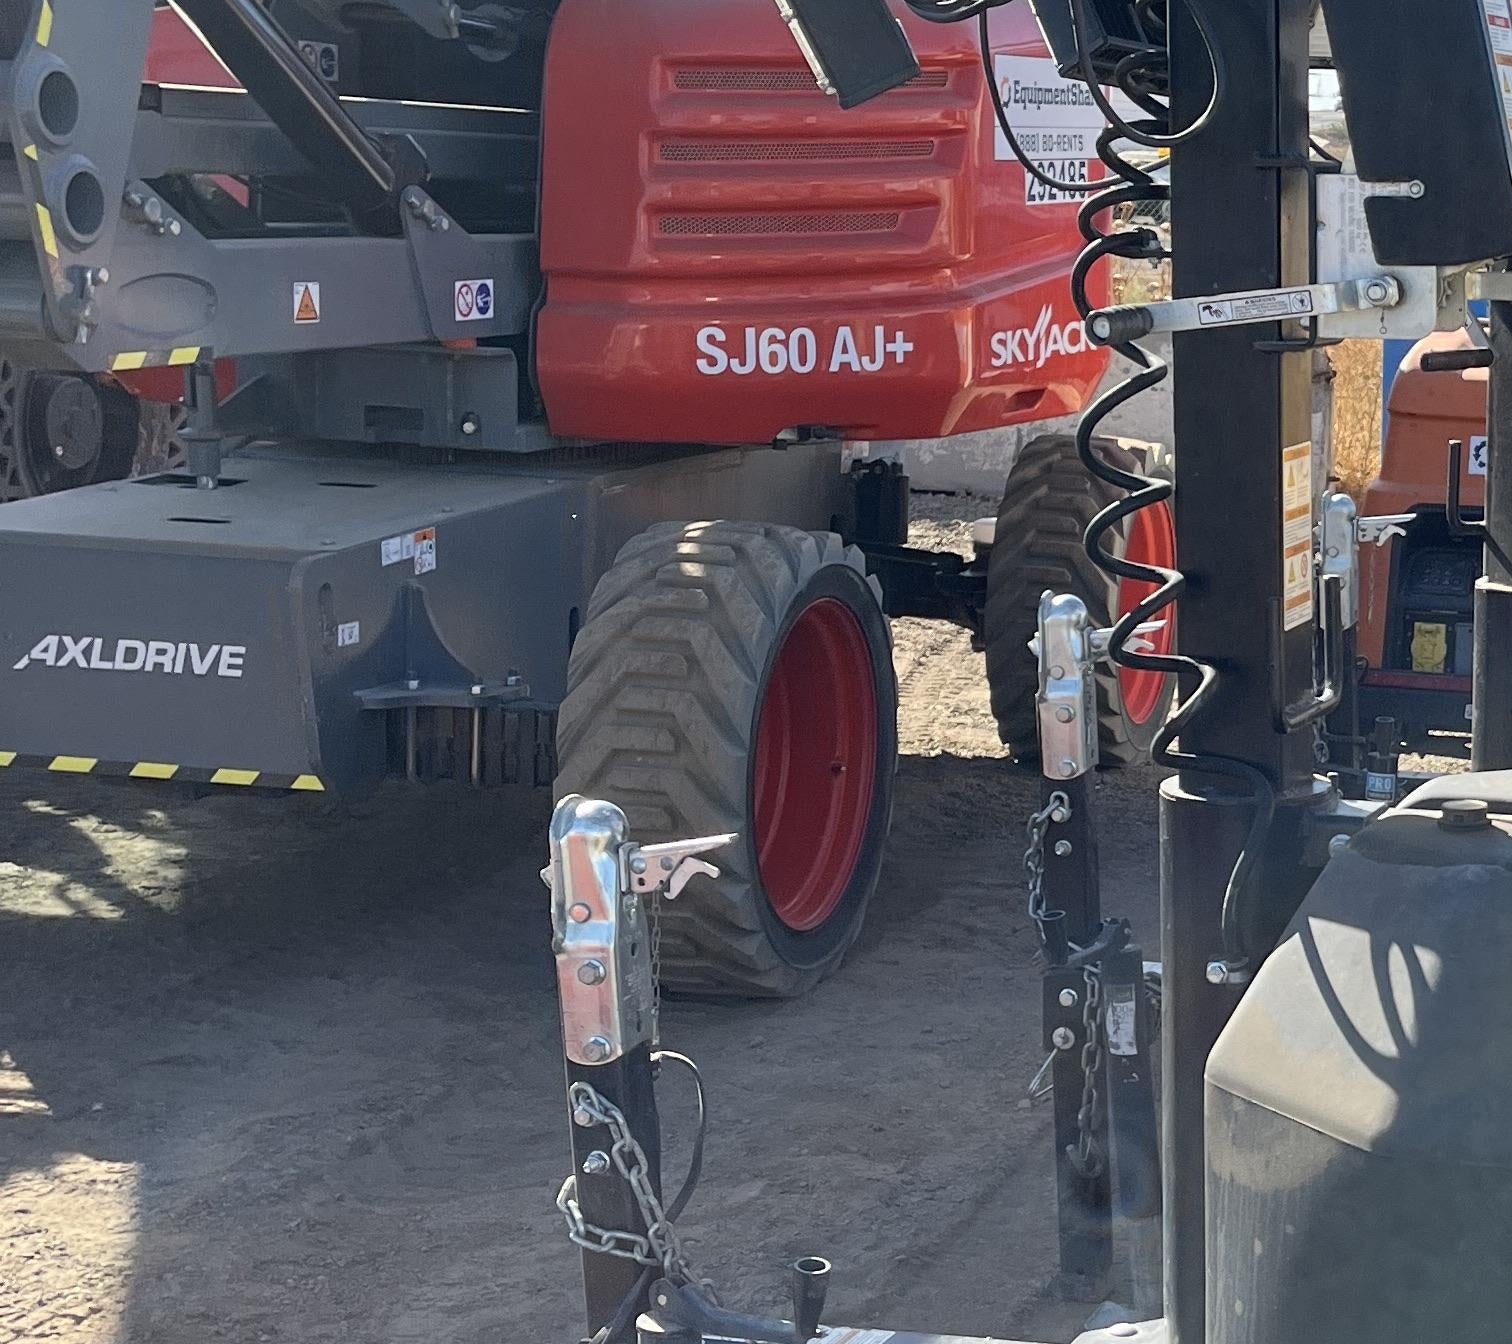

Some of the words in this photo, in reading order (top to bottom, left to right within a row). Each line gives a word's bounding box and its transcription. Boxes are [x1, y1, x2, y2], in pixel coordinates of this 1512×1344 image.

[1013, 80, 1095, 111] EquipmentSha
[1042, 134, 1084, 152] 80-RENTS
[696, 325, 817, 375] SJ60
[828, 324, 914, 373] AJ+
[12, 634, 247, 678] AXLDRIVE
[1368, 776, 1392, 791] PRO
